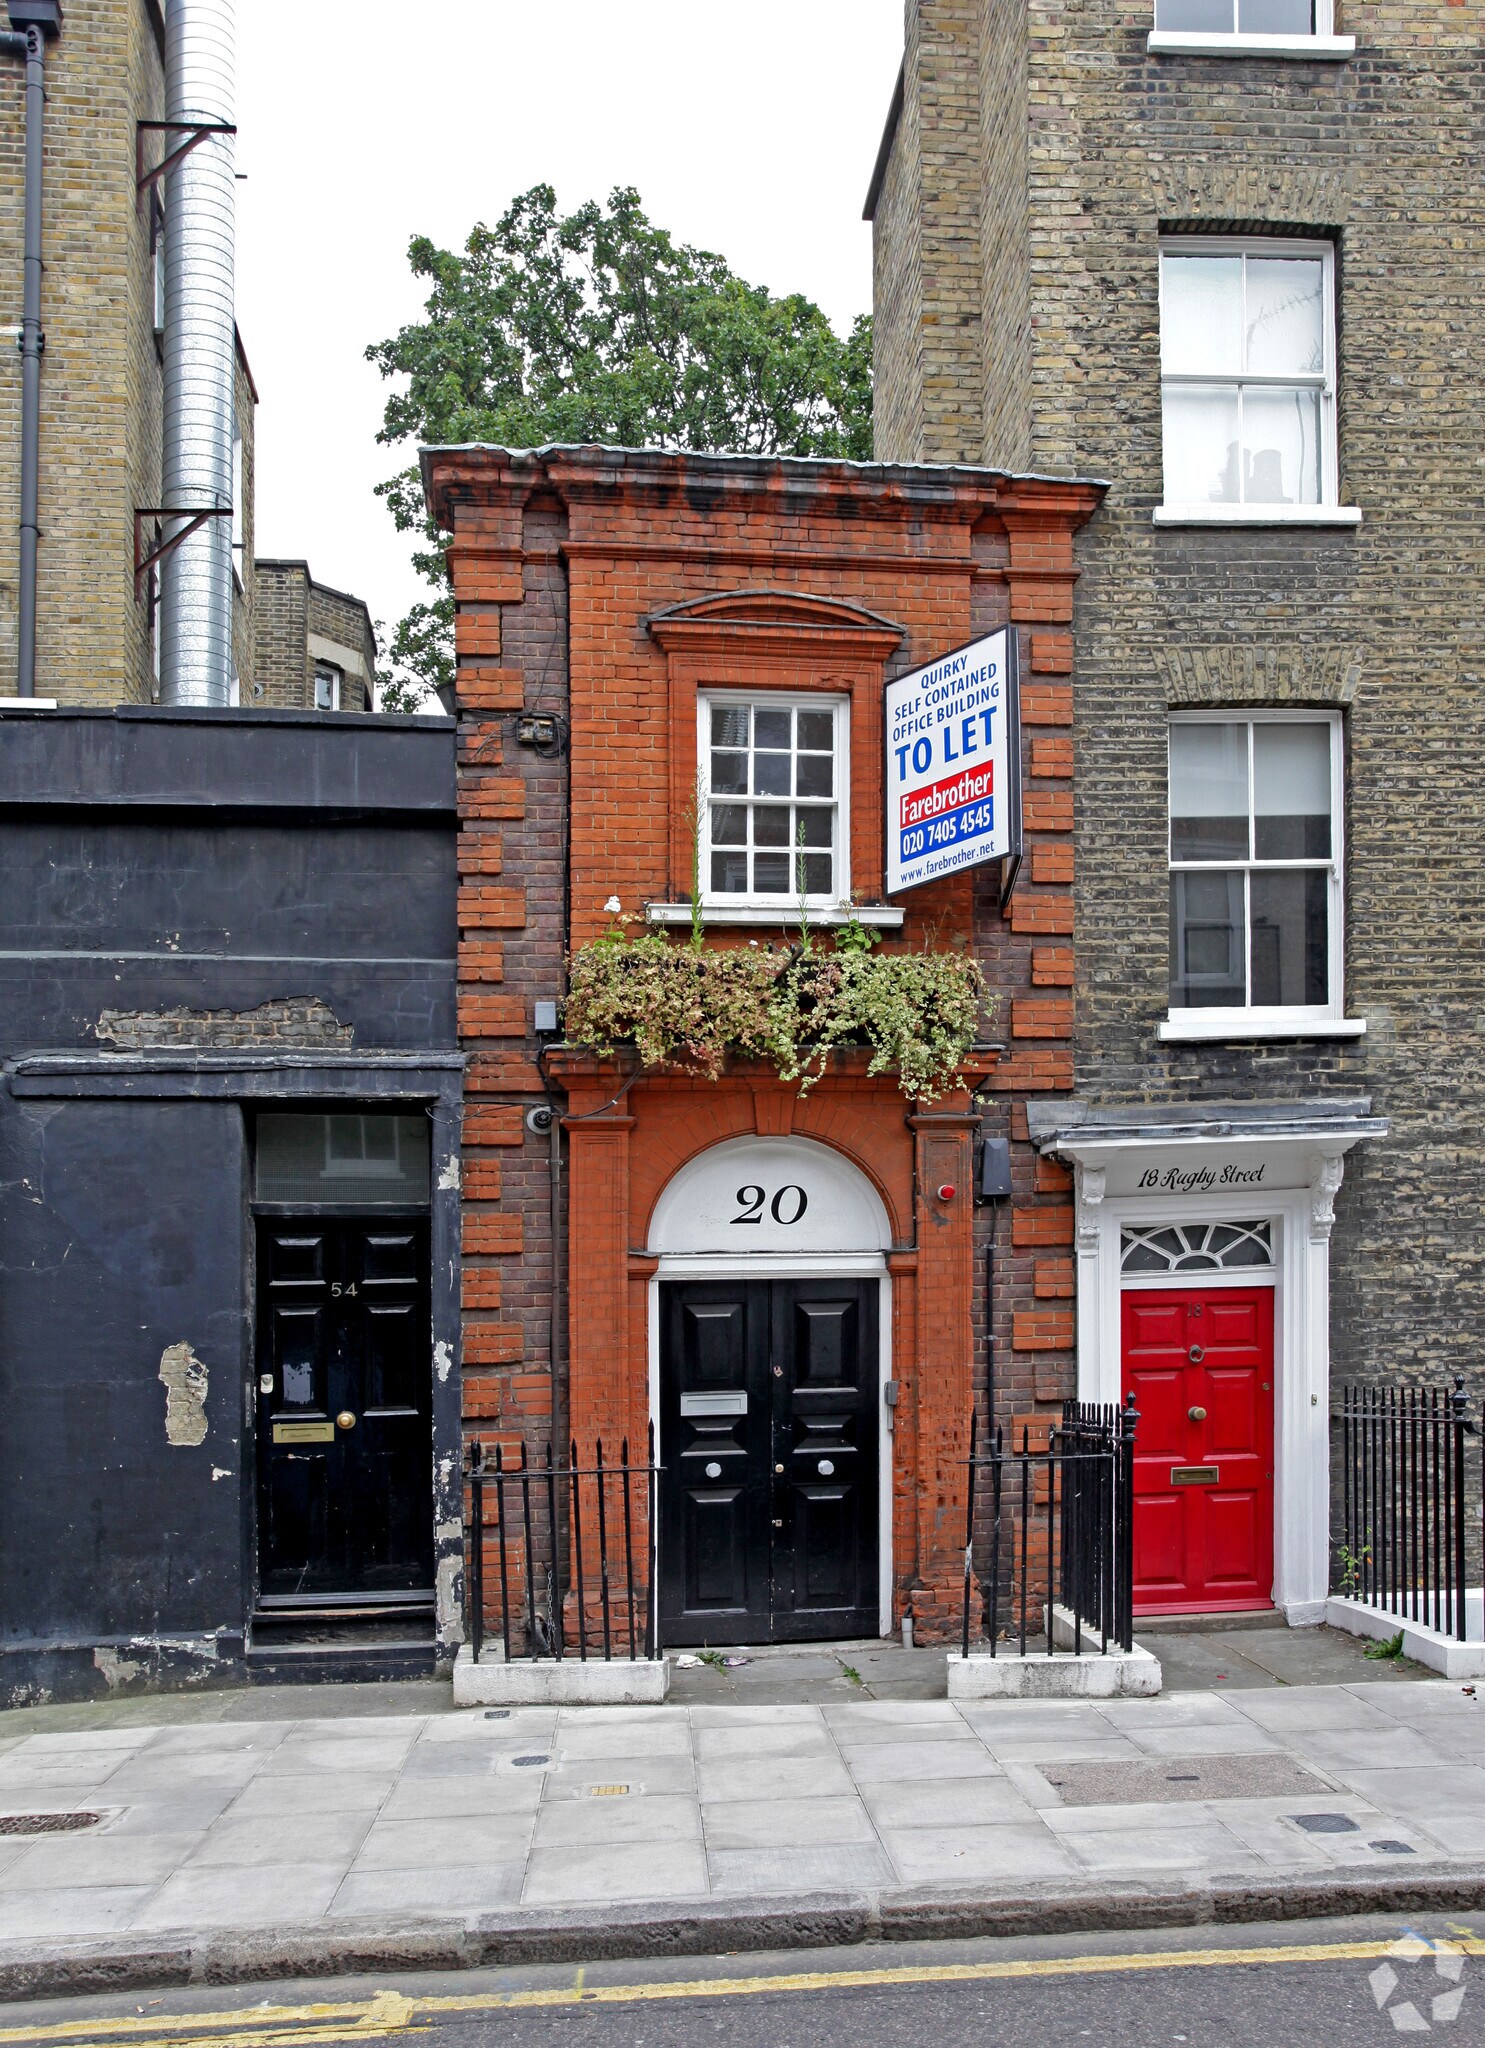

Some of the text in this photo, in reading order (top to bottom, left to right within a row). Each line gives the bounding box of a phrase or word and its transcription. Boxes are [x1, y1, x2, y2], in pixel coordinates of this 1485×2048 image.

[895, 663, 997, 722] SELF CONTAINED
[921, 655, 968, 689] QUIRKY
[893, 682, 999, 741] OFFICE BUILDING
[895, 706, 997, 781] TO LET
[902, 772, 991, 824] Farebrother
[904, 803, 990, 855] 020 7405 4545
[901, 840, 994, 883] www.farebrother.net
[1138, 1164, 1265, 1191] 18 Rugby Street
[730, 1185, 808, 1224] 20
[331, 1283, 358, 1297] 54
[1188, 1302, 1202, 1317] 18
